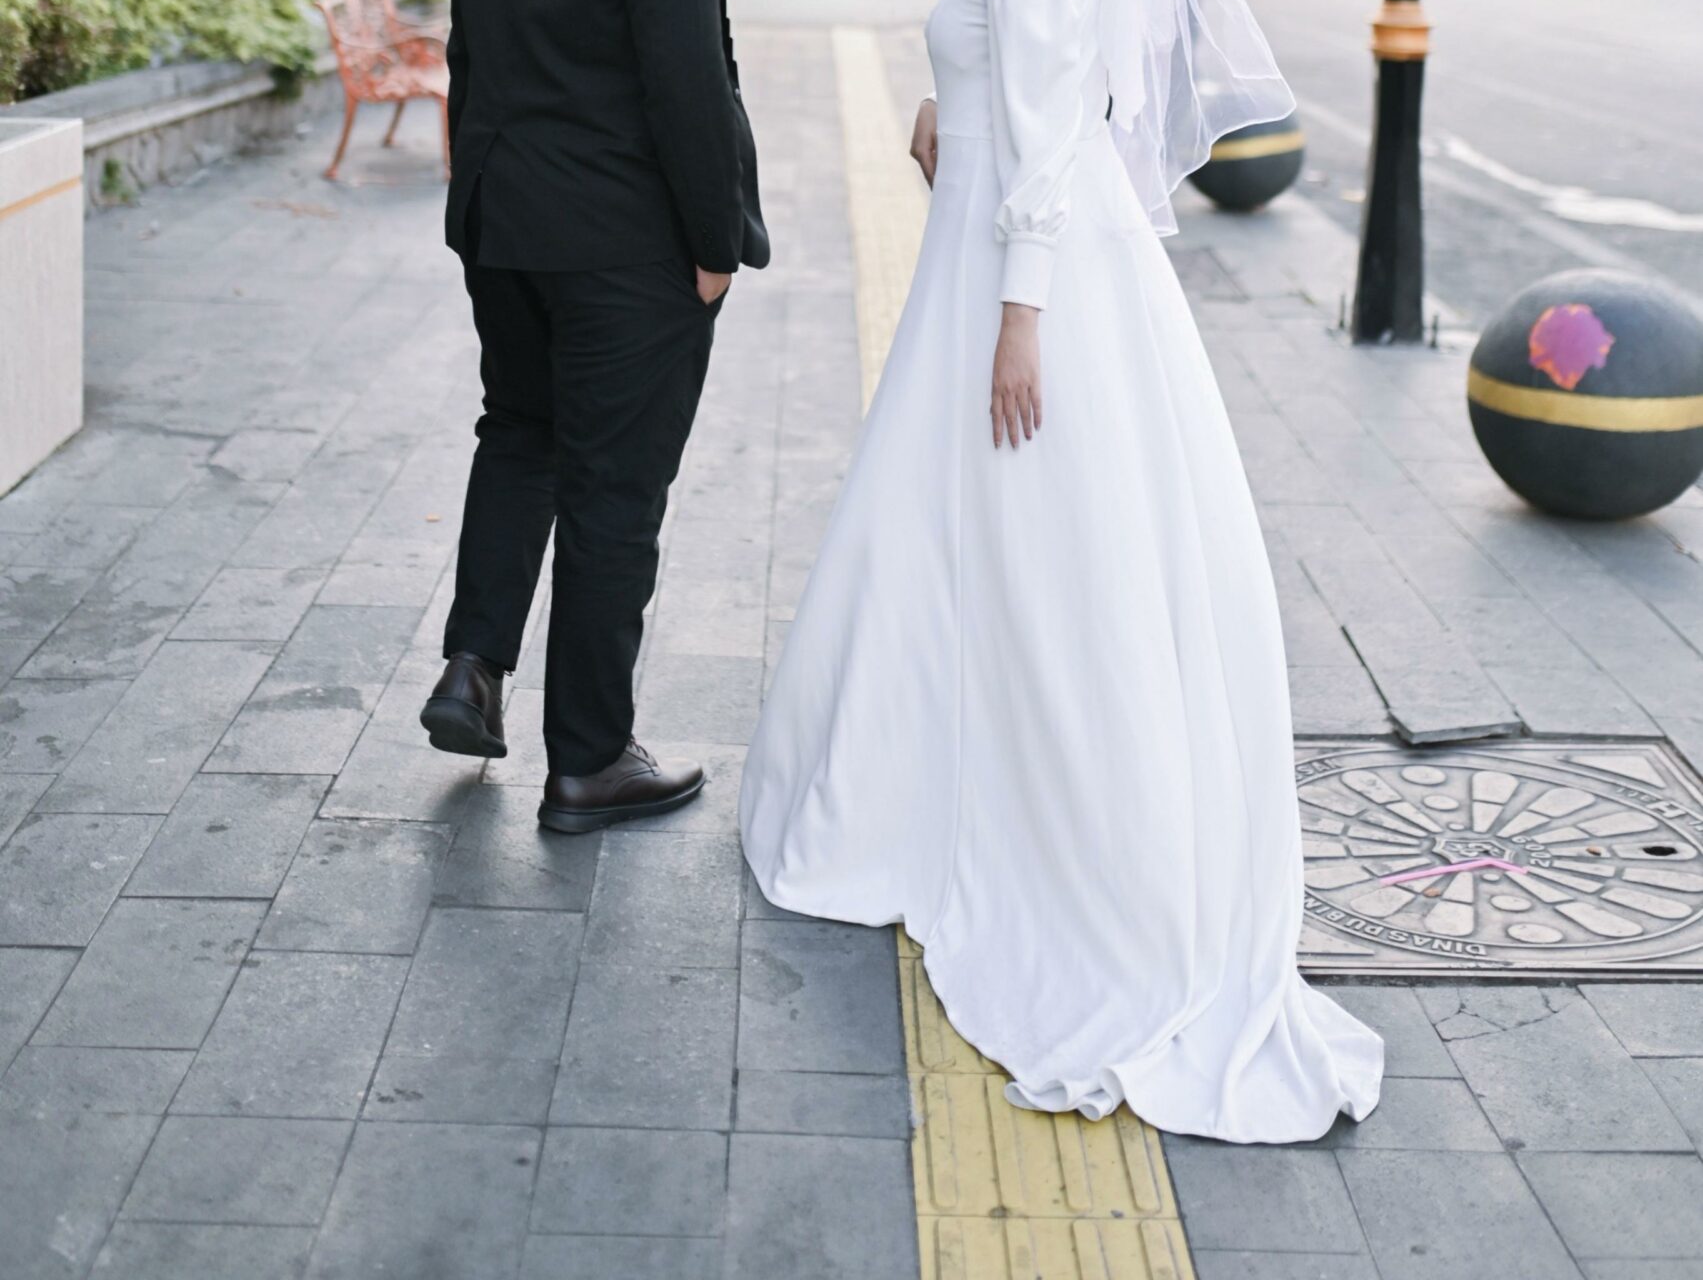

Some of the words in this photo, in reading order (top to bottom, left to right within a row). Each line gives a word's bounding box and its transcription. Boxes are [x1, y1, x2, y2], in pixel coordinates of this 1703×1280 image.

[1513, 835, 1549, 867] 2009
[1347, 918, 1384, 937] PU
[1388, 930, 1487, 956] DINAS
